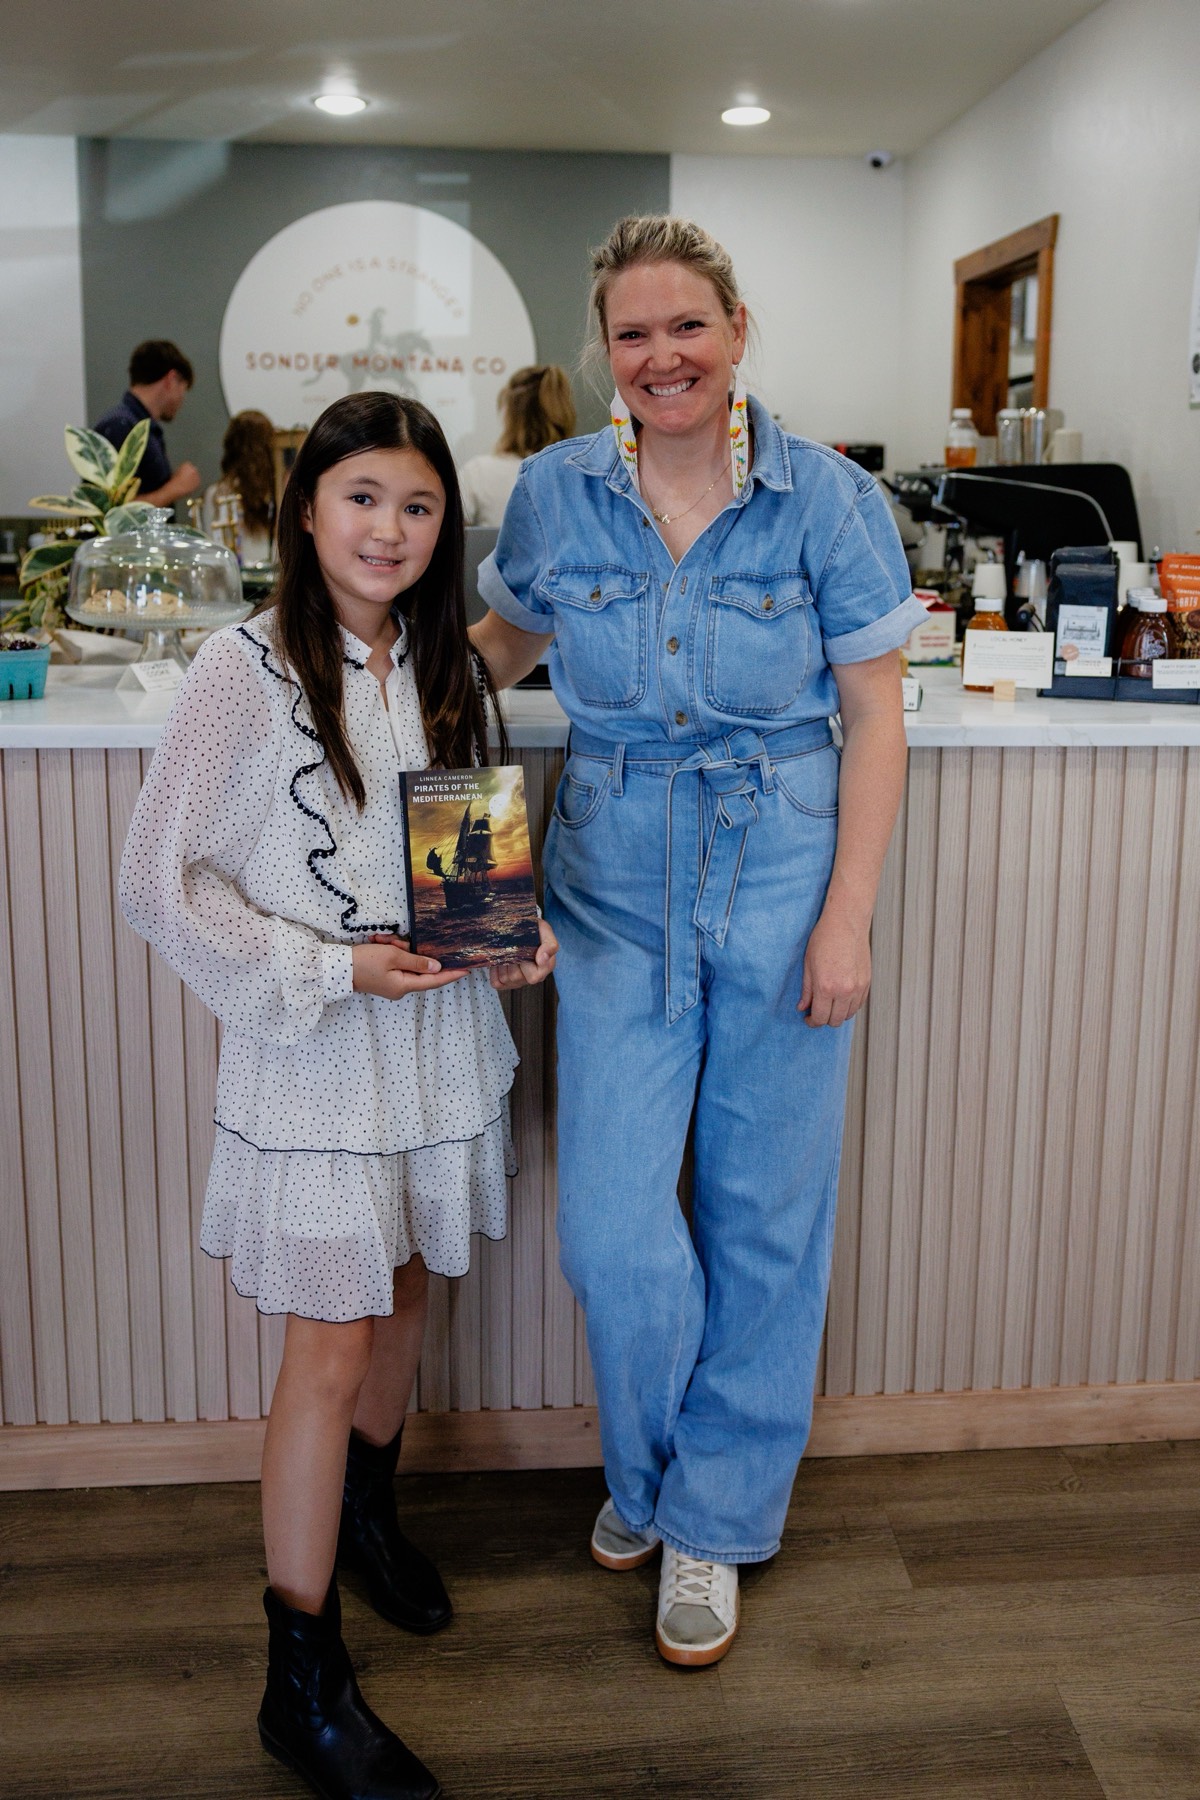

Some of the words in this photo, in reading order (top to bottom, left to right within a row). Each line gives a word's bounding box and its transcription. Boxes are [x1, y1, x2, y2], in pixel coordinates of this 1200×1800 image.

[246, 352, 340, 372] SONDER
[352, 353, 464, 373] MONTANA
[472, 356, 507, 376] CO
[414, 784, 449, 793] PIRATES
[451, 783, 462, 791] OF
[464, 782, 480, 790] THE
[412, 793, 483, 803] MEDITERRANEAN
